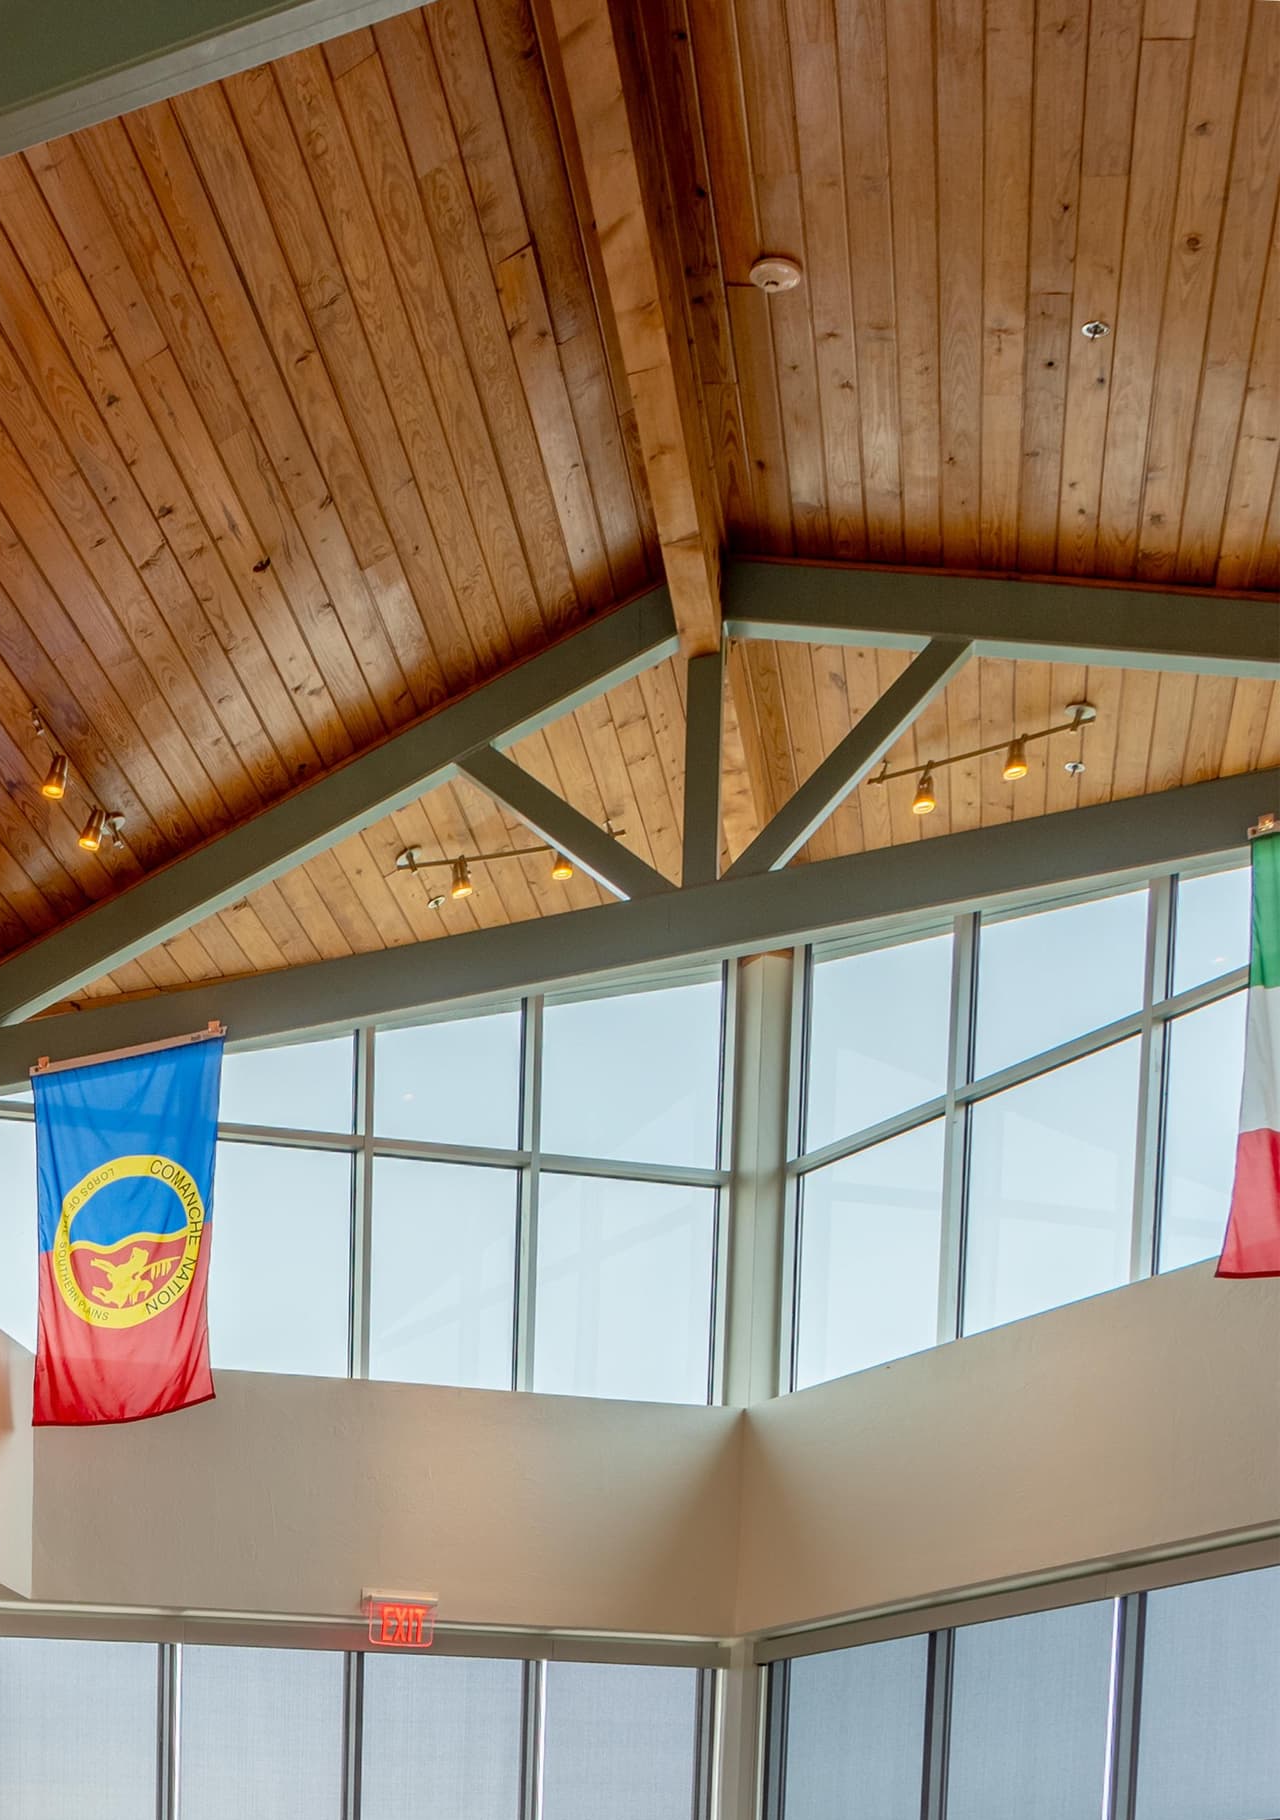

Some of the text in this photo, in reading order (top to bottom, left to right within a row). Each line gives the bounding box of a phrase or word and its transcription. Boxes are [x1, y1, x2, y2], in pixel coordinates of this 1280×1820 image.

[80, 1168, 115, 1197] LORDS
[68, 1198, 81, 1211] OF
[145, 1159, 203, 1315] COMANCHE NATION
[56, 1242, 78, 1303] SOUTHERN
[78, 1300, 109, 1321] PLAINS
[382, 1606, 427, 1643] EXIT
